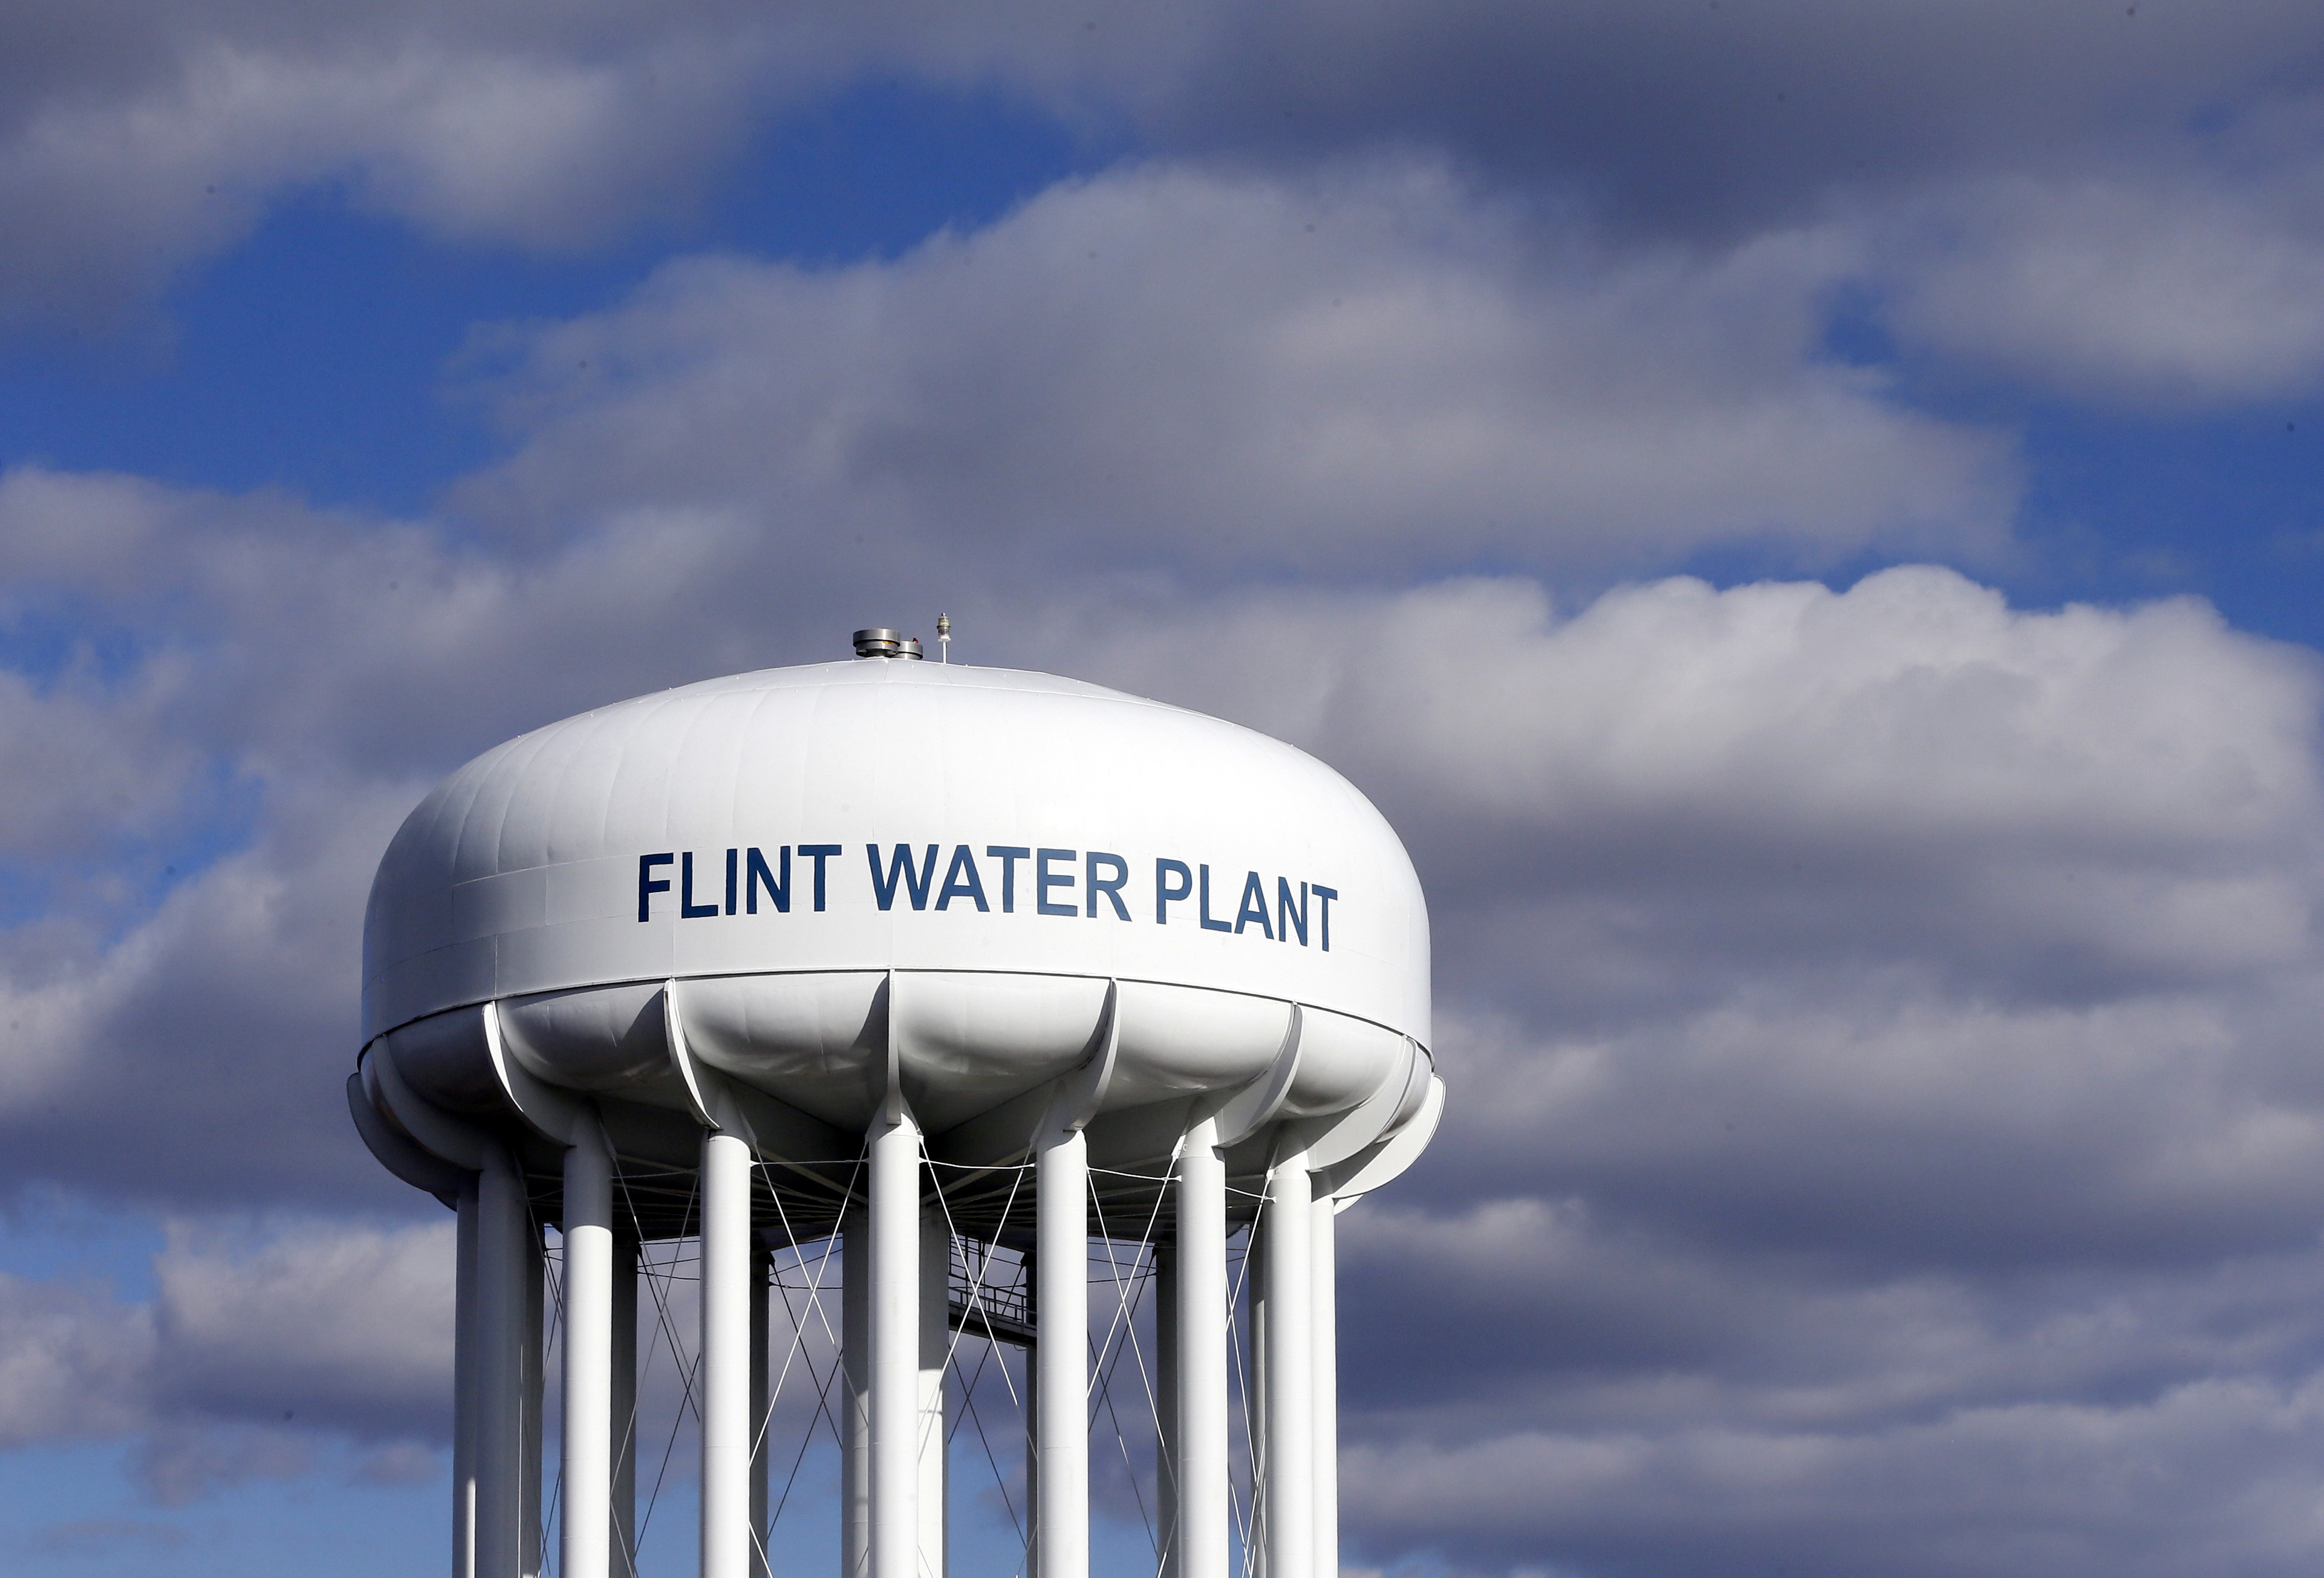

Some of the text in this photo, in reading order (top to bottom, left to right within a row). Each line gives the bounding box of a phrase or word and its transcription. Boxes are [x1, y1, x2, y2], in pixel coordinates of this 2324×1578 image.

[637, 843, 1338, 952] FLINT WATER PLANT
